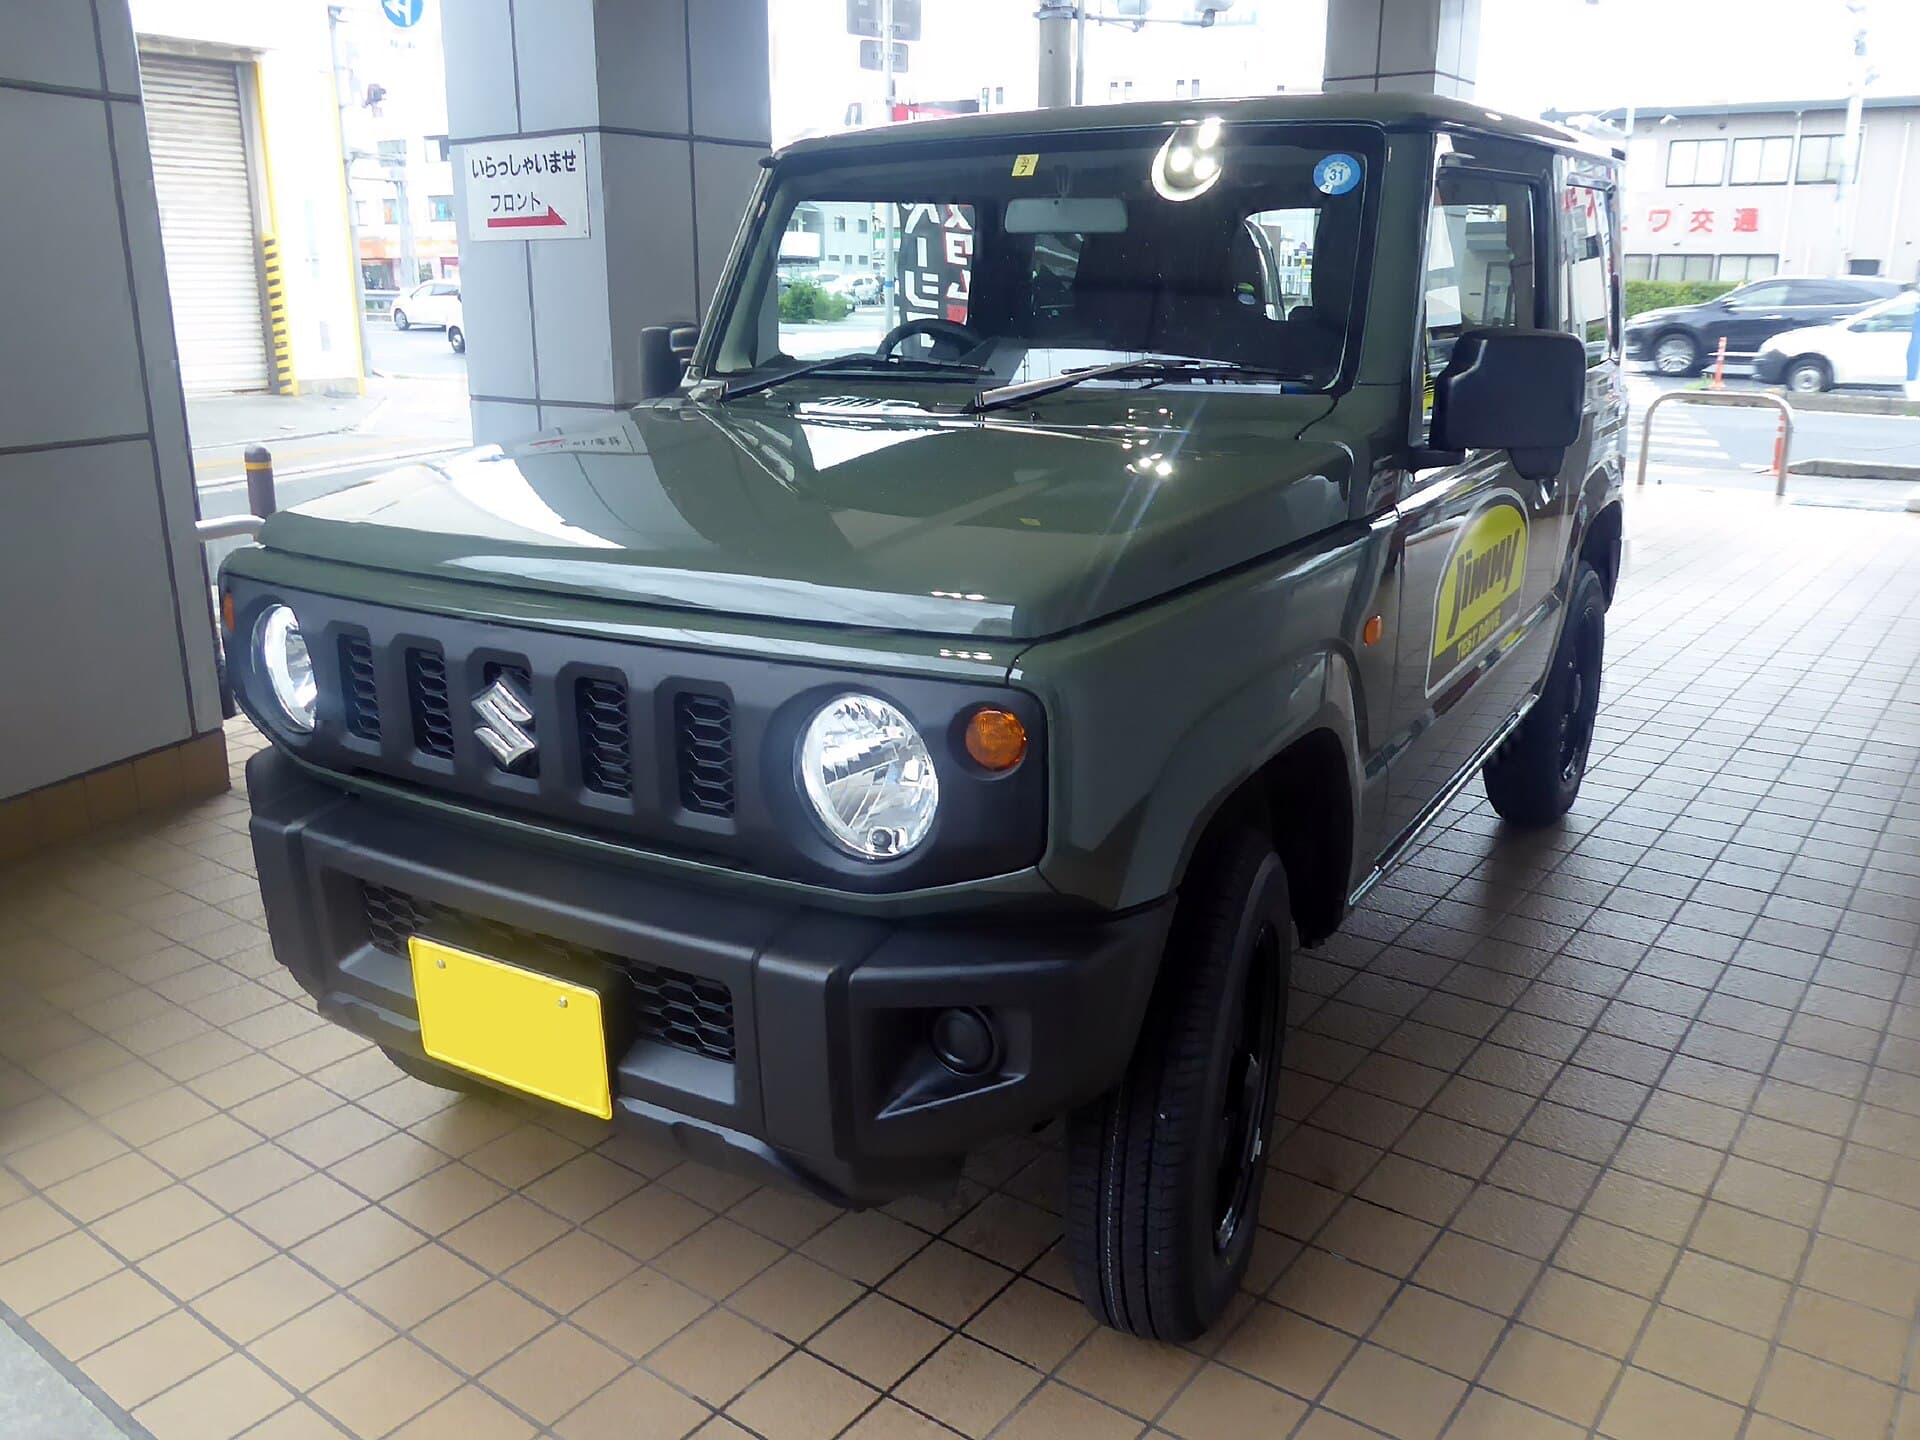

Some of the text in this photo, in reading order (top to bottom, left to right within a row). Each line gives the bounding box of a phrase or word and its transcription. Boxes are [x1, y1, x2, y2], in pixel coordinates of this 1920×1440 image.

[472, 149, 577, 179] いらっしゃいませ
[1329, 168, 1344, 181] 31
[491, 192, 541, 212] フロント
[1622, 207, 1759, 233] ワ交通
